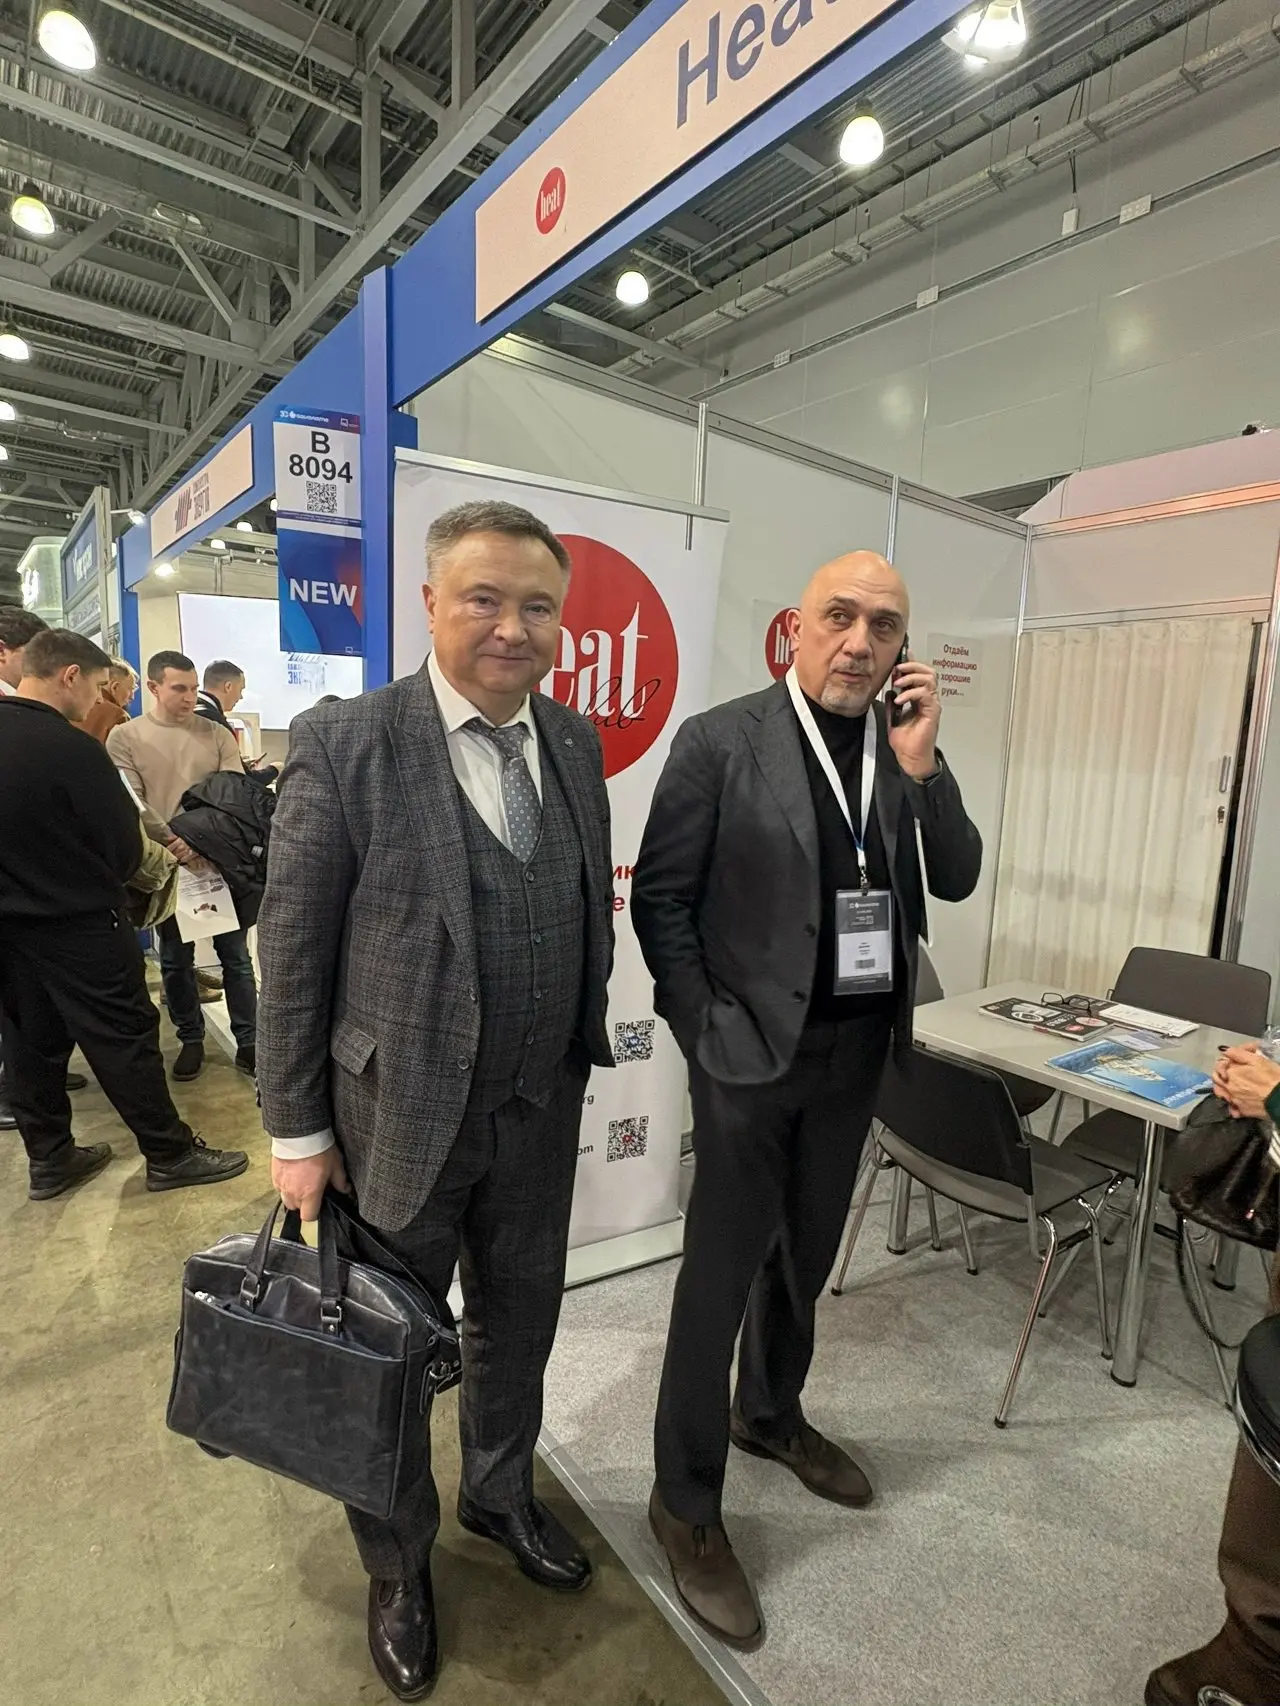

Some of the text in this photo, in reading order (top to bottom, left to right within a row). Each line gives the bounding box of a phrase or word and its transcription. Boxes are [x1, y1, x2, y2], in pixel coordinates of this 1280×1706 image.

[677, 0, 836, 129] Hea
[311, 431, 331, 455] B
[289, 454, 353, 484] 8094
[289, 578, 357, 607] NEW
[539, 601, 648, 718] eat
[943, 644, 969, 656] Отдаём
[932, 658, 977, 671] информацию
[940, 673, 971, 684] хорошие
